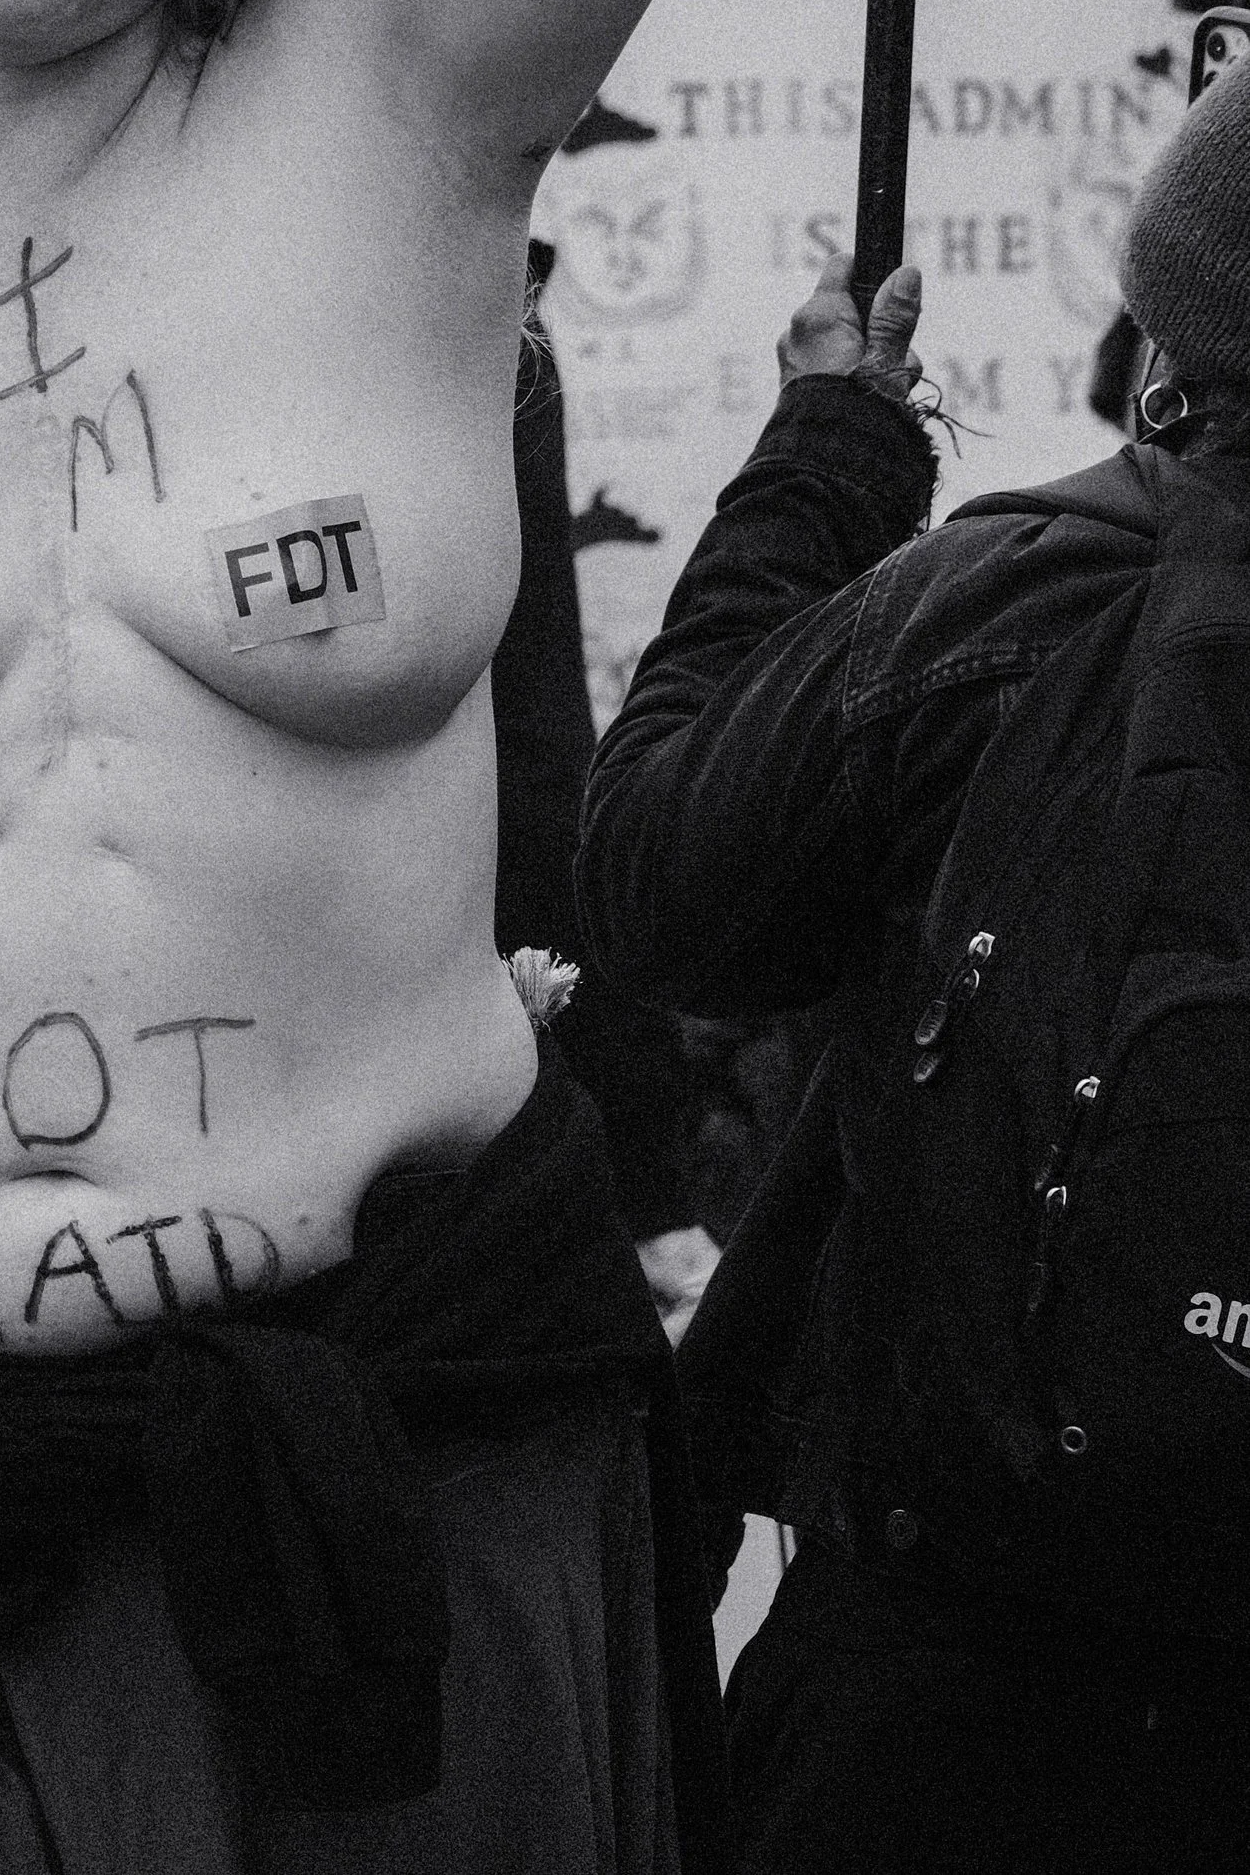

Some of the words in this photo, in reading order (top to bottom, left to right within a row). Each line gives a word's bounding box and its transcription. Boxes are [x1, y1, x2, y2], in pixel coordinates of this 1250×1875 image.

[670, 78, 858, 138] THIS
[771, 212, 842, 271] IS
[224, 519, 363, 618] FDT
